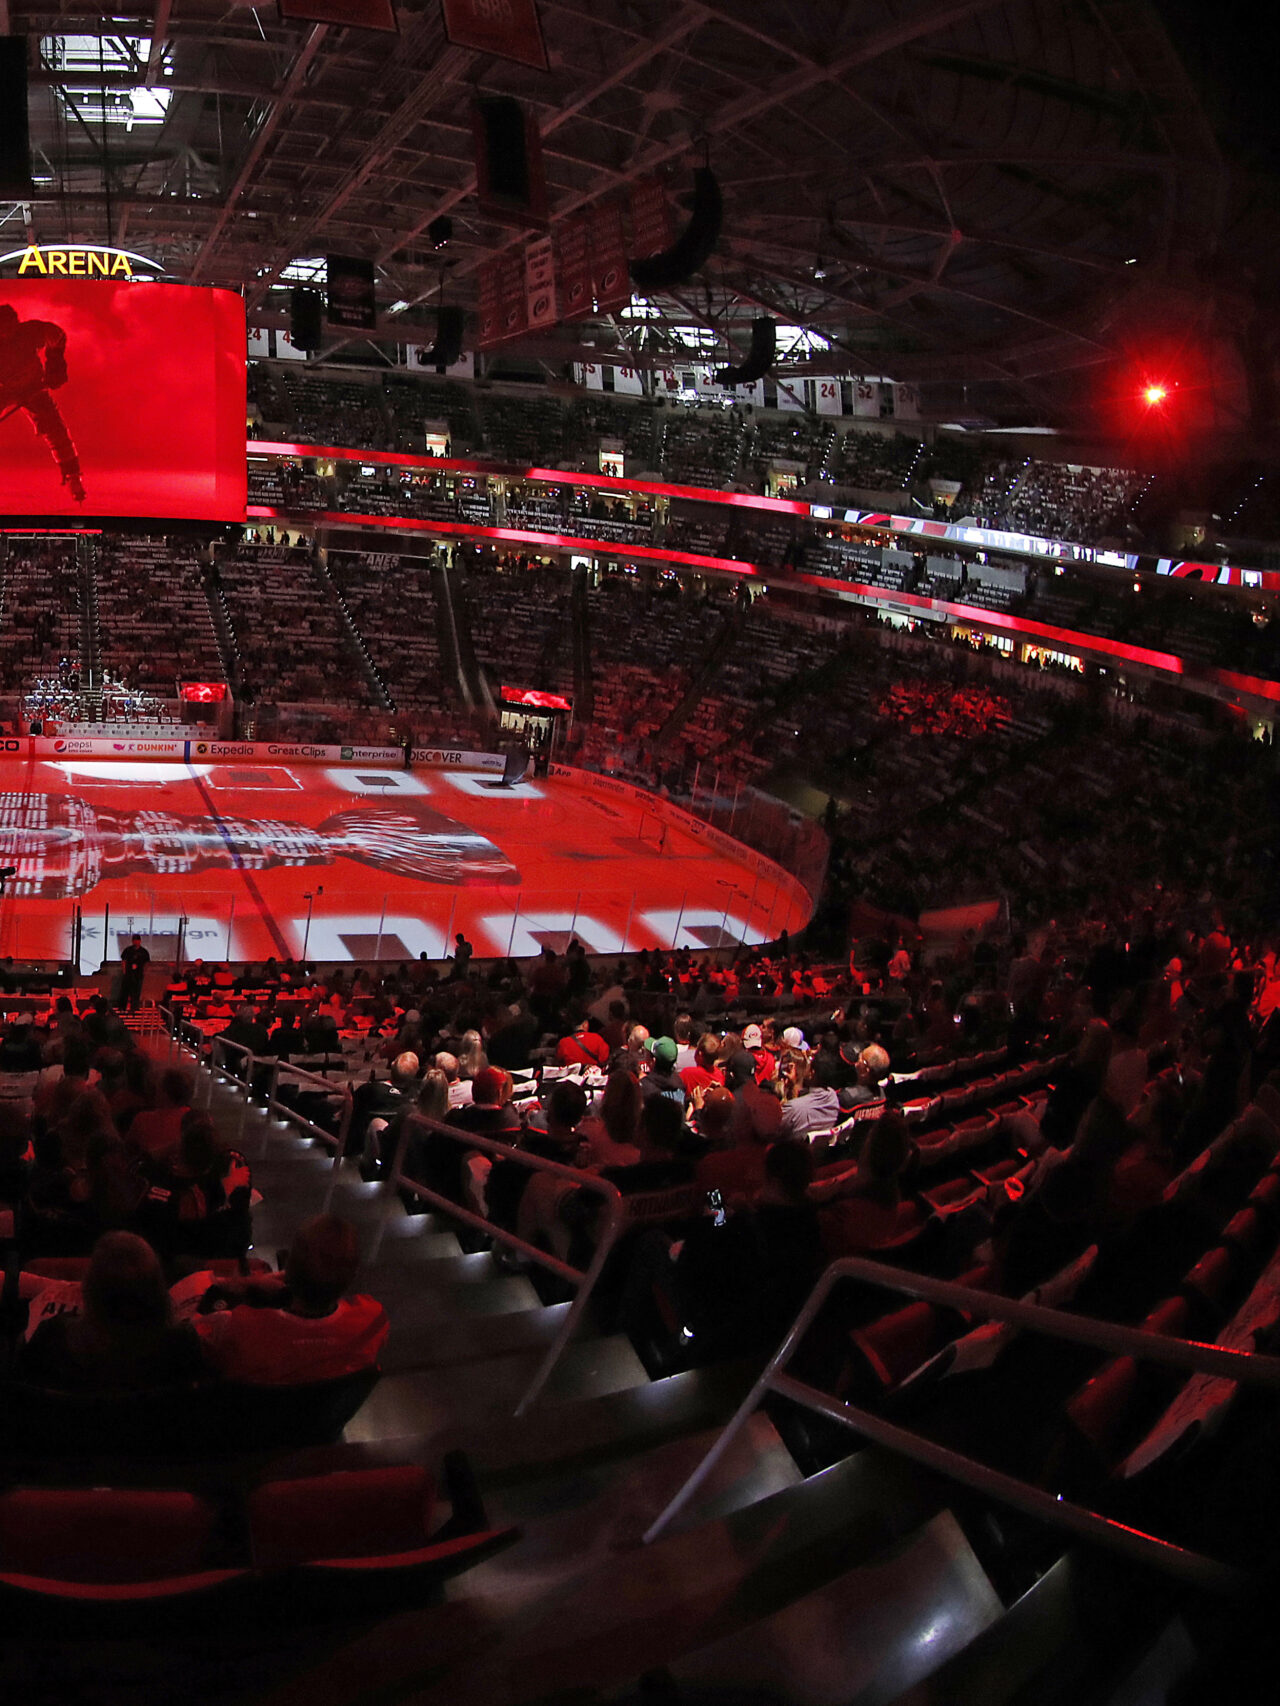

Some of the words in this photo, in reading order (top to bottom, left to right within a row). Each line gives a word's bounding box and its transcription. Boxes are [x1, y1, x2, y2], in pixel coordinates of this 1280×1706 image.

[18, 245, 133, 276] ARENA
[821, 383, 836, 398] 24
[359, 552, 401, 567] CANES
[68, 741, 92, 750] pepsi
[137, 743, 178, 752] DUNKIN'
[211, 744, 255, 756] Expedia
[267, 744, 299, 756] Great
[301, 746, 326, 757] Clips
[409, 750, 462, 764] DISCOVER
